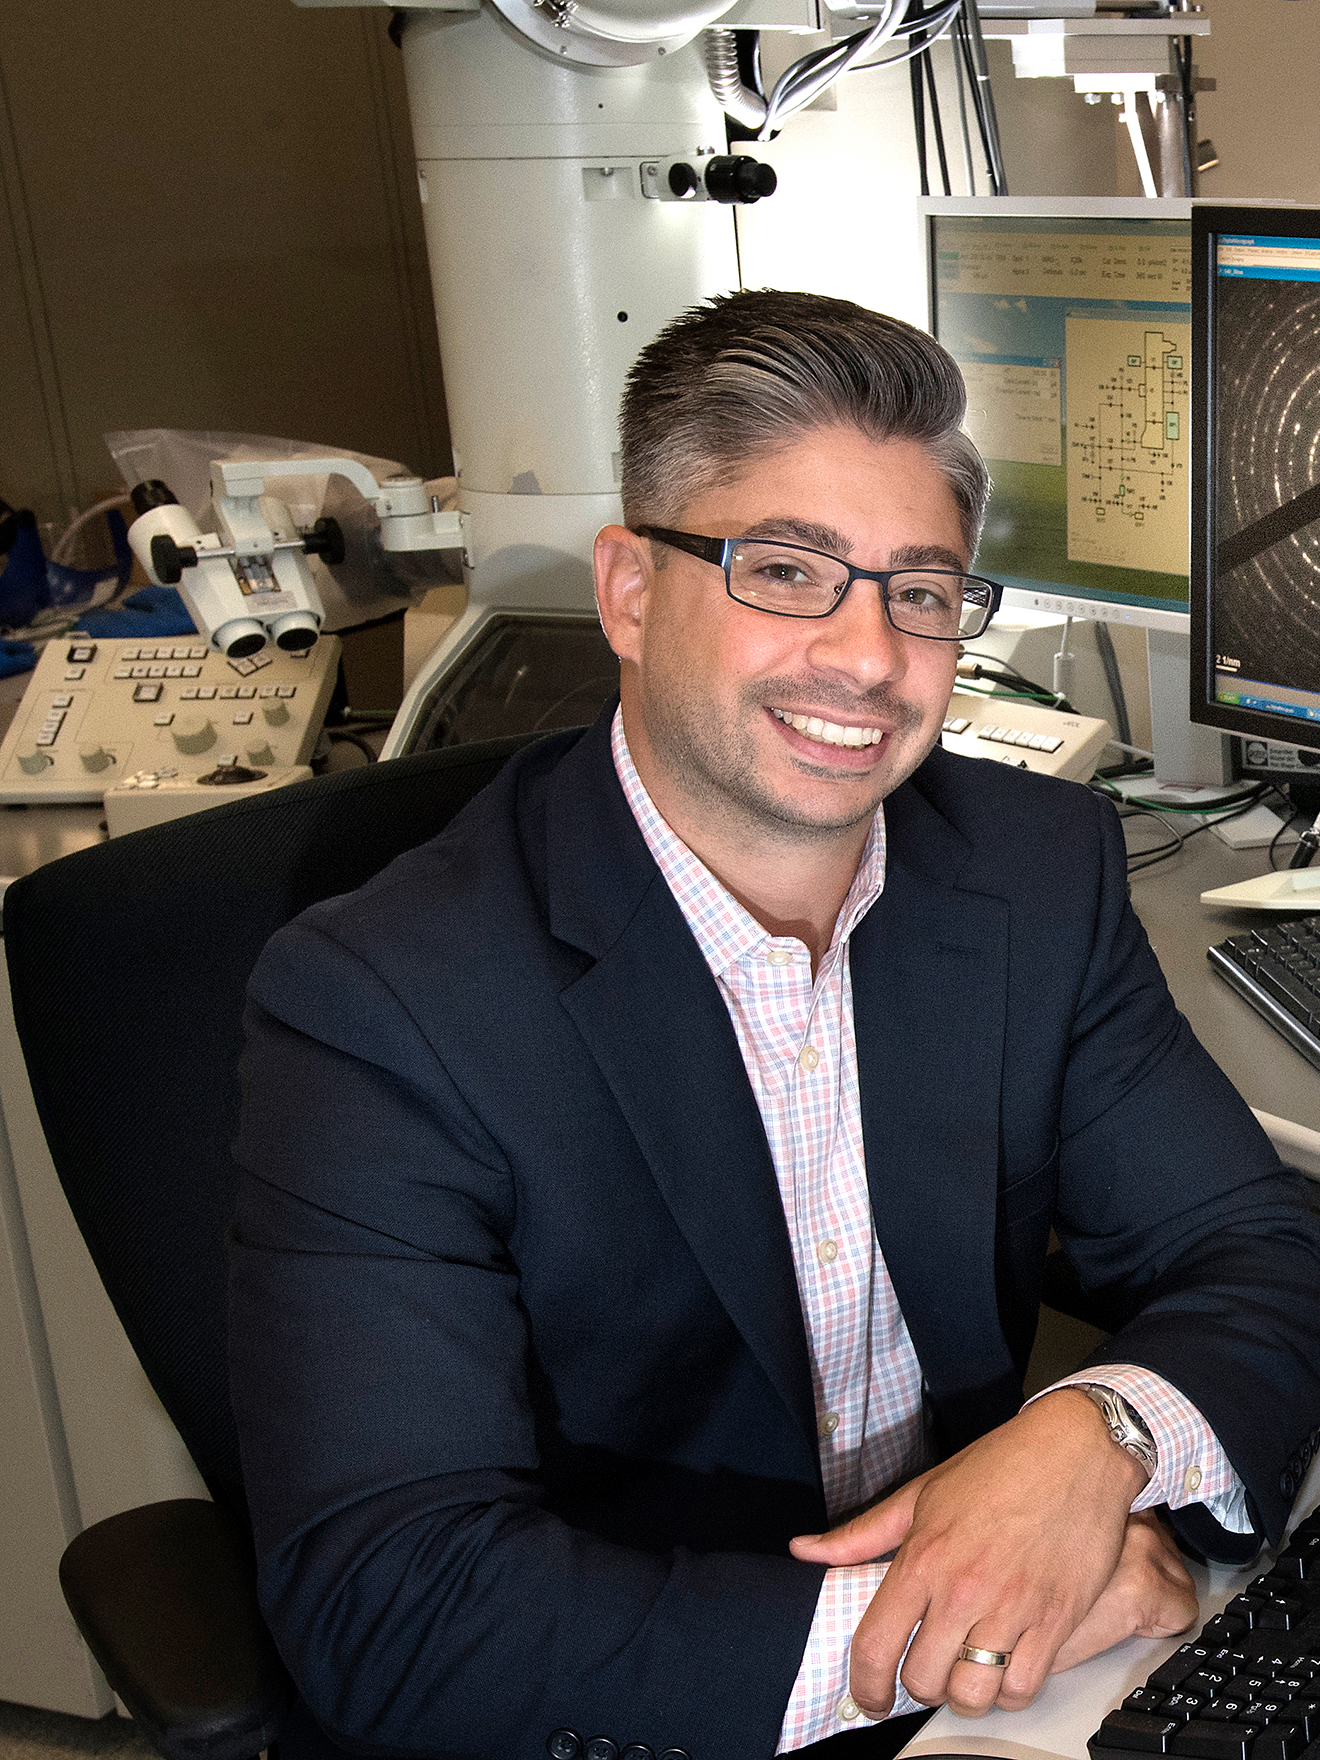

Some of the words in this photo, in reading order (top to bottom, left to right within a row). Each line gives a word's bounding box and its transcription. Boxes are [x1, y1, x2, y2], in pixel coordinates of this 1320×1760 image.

[1216, 1648, 1229, 1659] End
[1209, 1674, 1223, 1683] 2
[1249, 1679, 1262, 1687] 5
[1132, 1689, 1144, 1699] Del
[1186, 1697, 1198, 1706] 3
[1225, 1702, 1238, 1711] 6
[1264, 1704, 1277, 1712] 9
